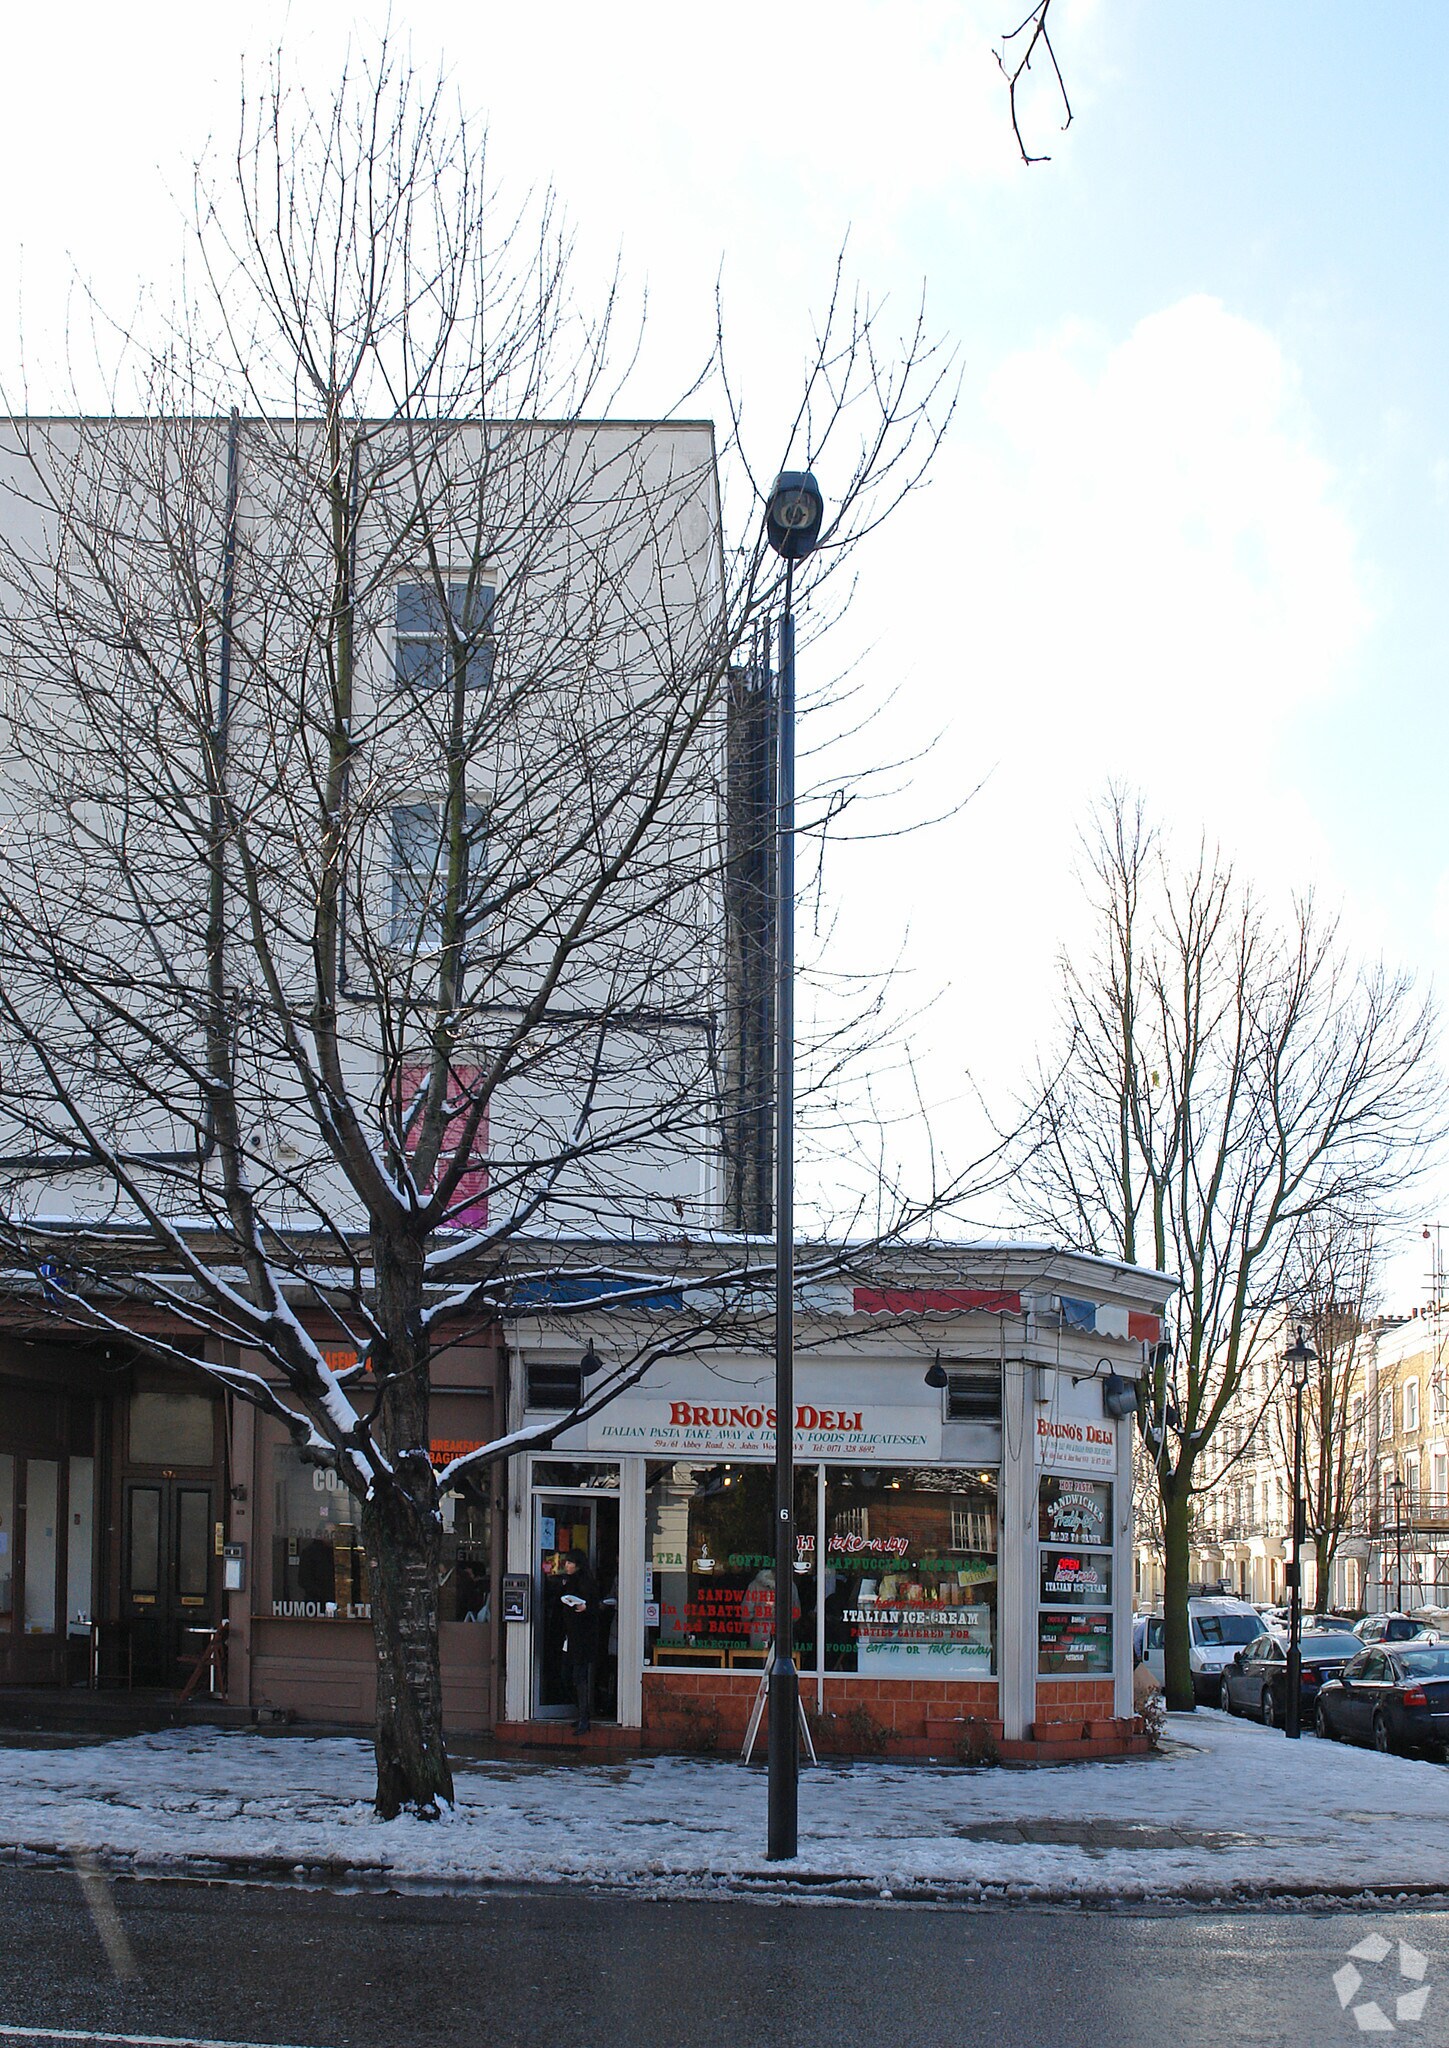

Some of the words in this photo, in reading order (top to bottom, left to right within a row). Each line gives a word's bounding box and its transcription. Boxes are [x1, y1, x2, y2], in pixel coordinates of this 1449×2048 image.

[669, 1402, 776, 1429] BRUNO'S
[794, 1405, 863, 1431] DELI
[602, 1426, 646, 1437] ITALIAN
[650, 1428, 680, 1438] PASTA
[685, 1429, 711, 1438] TAKE
[715, 1430, 744, 1440] AWAY
[747, 1431, 755, 1440] &
[760, 1431, 805, 1442] ITAN
[807, 1433, 845, 1443] FOODS
[848, 1433, 927, 1445] DELICATESSEN
[1037, 1418, 1083, 1442] BRUNO'S
[1086, 1425, 1113, 1446] DELI
[681, 1441, 701, 1449] Abbey
[705, 1441, 724, 1450] Road,
[740, 1442, 759, 1450] Johns
[827, 1444, 841, 1452] 0171
[858, 1445, 876, 1453] 8692
[1059, 1480, 1073, 1491] HOT
[1074, 1481, 1094, 1493] PASTA
[780, 1508, 789, 1520] 6
[1047, 1494, 1104, 1524] SANDWICHES
[796, 1535, 816, 1550] LI
[656, 1552, 683, 1565] TEA
[826, 1557, 910, 1571] CAPPUCCINO
[919, 1559, 987, 1573] ESPRESSO
[1058, 1558, 1080, 1570] OPEN
[1045, 1582, 1072, 1592] ITALIAN
[697, 1589, 776, 1603] SANDWICHE
[661, 1603, 677, 1615] In
[683, 1605, 750, 1618] CIABATTA
[754, 1606, 801, 1619] BRD
[842, 1609, 899, 1623] ITALIAN
[903, 1611, 979, 1625] ICE-CREAM
[673, 1619, 702, 1633] And
[850, 1627, 893, 1638] PARTIES
[897, 1629, 944, 1639] CATERED
[950, 1630, 969, 1639] FOR
[826, 1642, 858, 1653] FOODS
[866, 1643, 900, 1655] eat-in
[907, 1645, 920, 1655] OR
[928, 1642, 992, 1656] take-away
